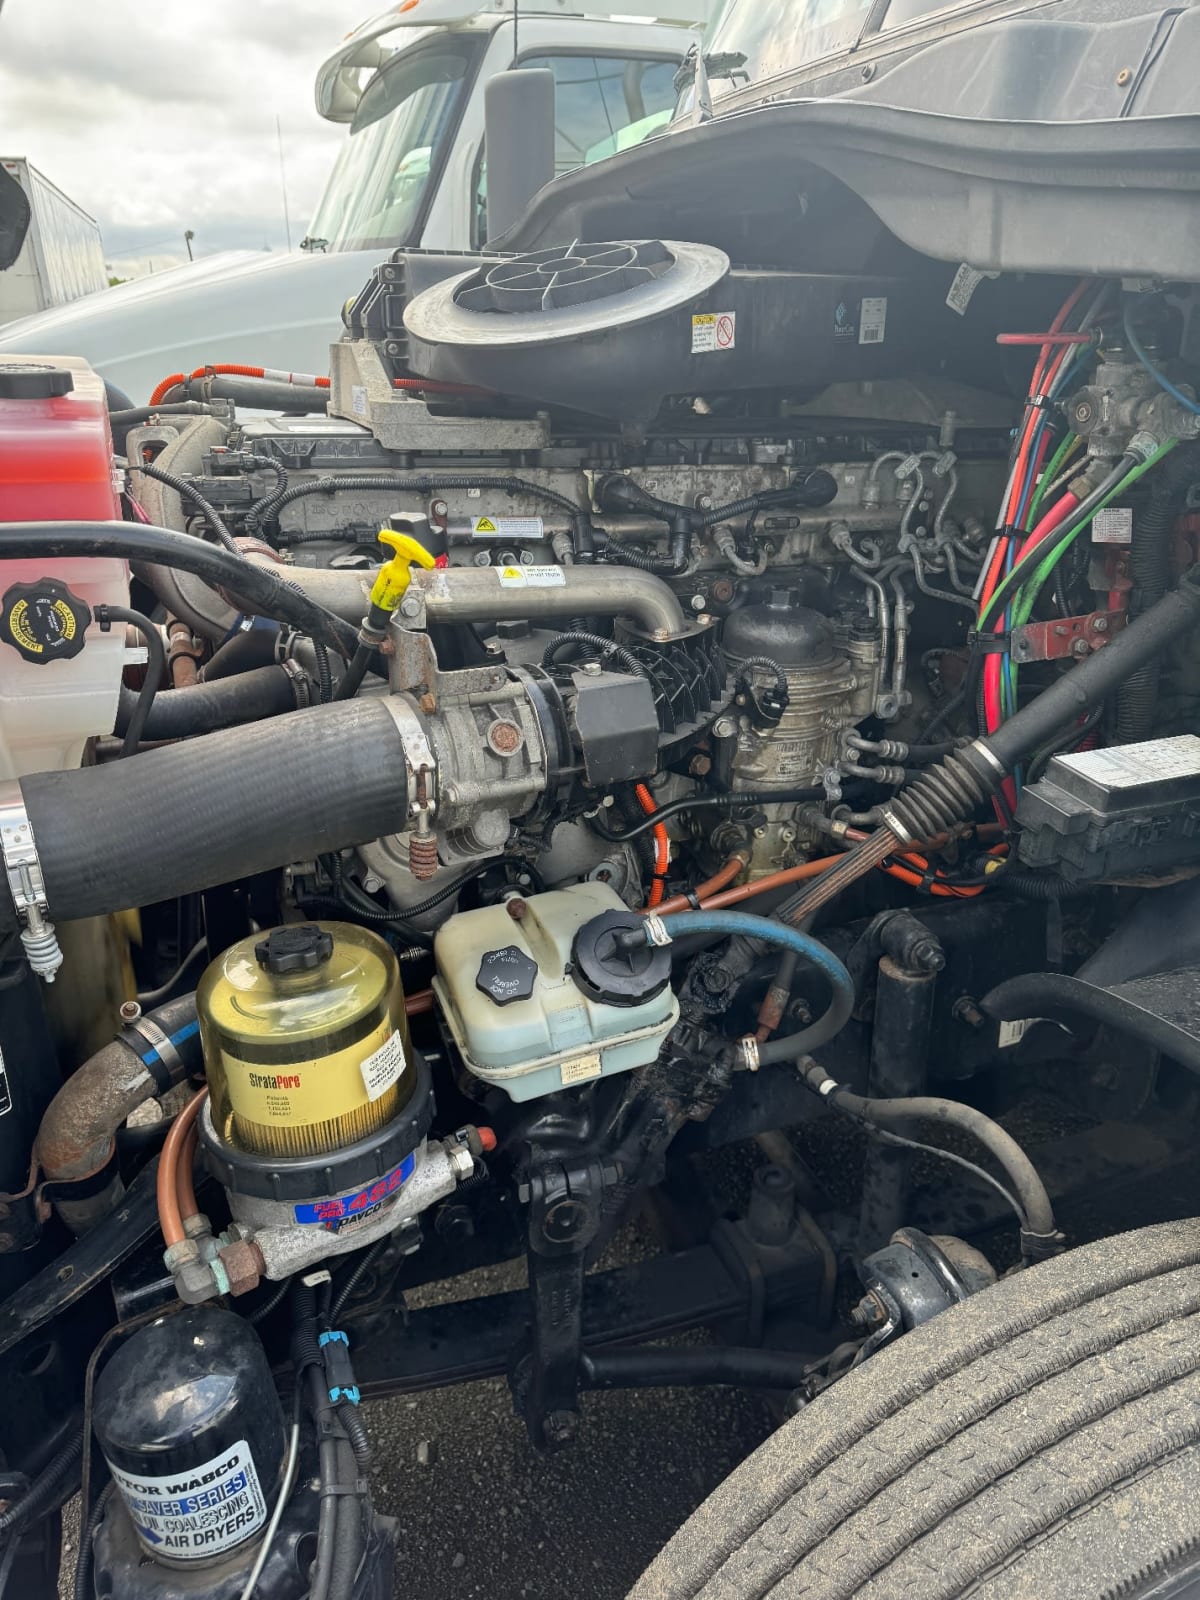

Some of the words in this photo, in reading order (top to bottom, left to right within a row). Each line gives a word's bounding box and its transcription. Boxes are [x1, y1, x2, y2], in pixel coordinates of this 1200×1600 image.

[10, 605, 42, 652] AVERTISSEMENT
[62, 606, 75, 638] CAUTION
[249, 1073, 301, 1089] StrataPore
[314, 1200, 345, 1213] FUEL
[318, 1209, 345, 1220] PRO
[338, 1202, 382, 1228] DAVCO
[166, 1455, 240, 1495] WABCO
[137, 1499, 183, 1516] SAVER
[187, 1474, 244, 1513] SERIES
[165, 1491, 250, 1533] COALESCING
[164, 1534, 190, 1548] AIR
[193, 1506, 255, 1546] DRYERS
